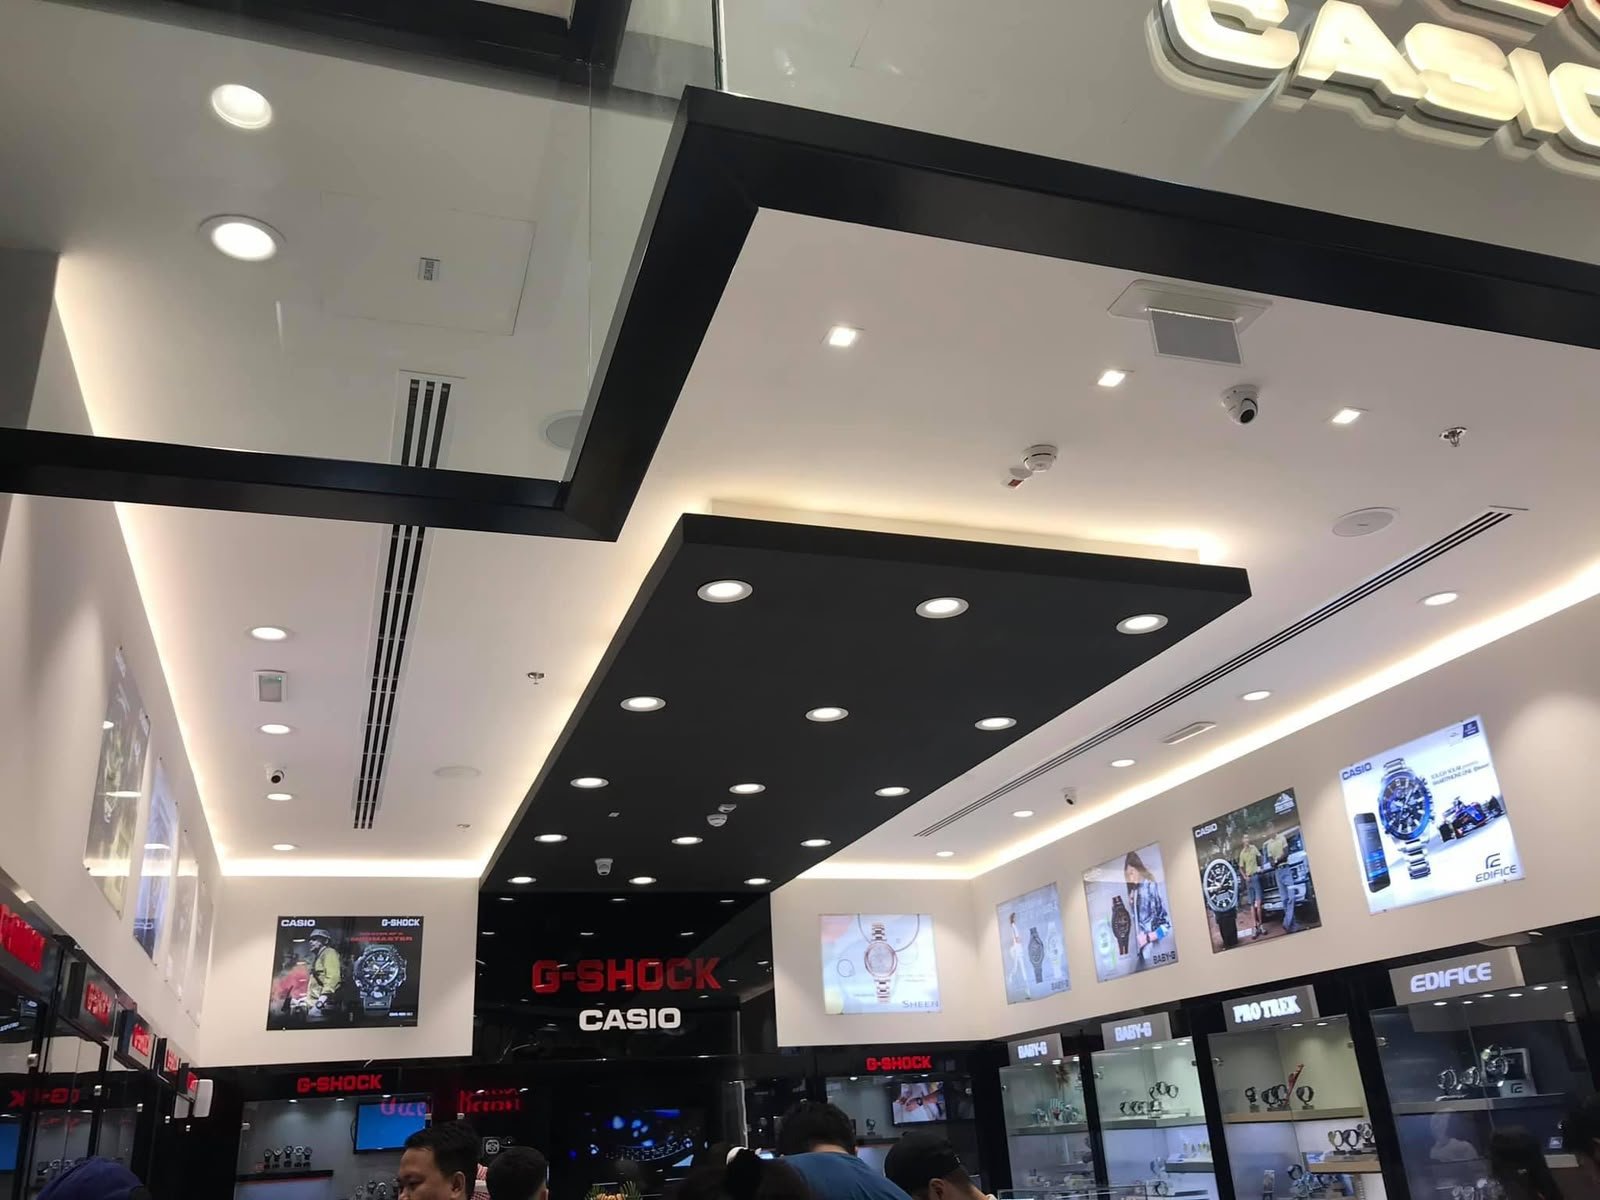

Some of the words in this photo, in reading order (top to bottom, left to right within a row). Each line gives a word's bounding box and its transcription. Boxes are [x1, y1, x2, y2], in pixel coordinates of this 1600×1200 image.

[1342, 762, 1373, 781] CASIO
[1195, 823, 1218, 838] CASIO
[1475, 864, 1518, 883] EDIFICE
[280, 919, 316, 927] CASIO
[381, 918, 420, 927] G-SHOCK
[1153, 951, 1176, 964] BABY-G
[532, 957, 721, 993] G-SHOCK
[1410, 962, 1492, 993] EDIFICE
[902, 1000, 939, 1008] SHEEN
[1232, 1002, 1260, 1023] PRO
[1260, 995, 1301, 1017] TREK
[579, 1007, 681, 1031] CASIO
[1114, 1022, 1152, 1042] BABY-G
[1017, 1041, 1048, 1059] BABY-G
[865, 1055, 933, 1071] G-SHOCK
[297, 1074, 382, 1093] G-SHOCK
